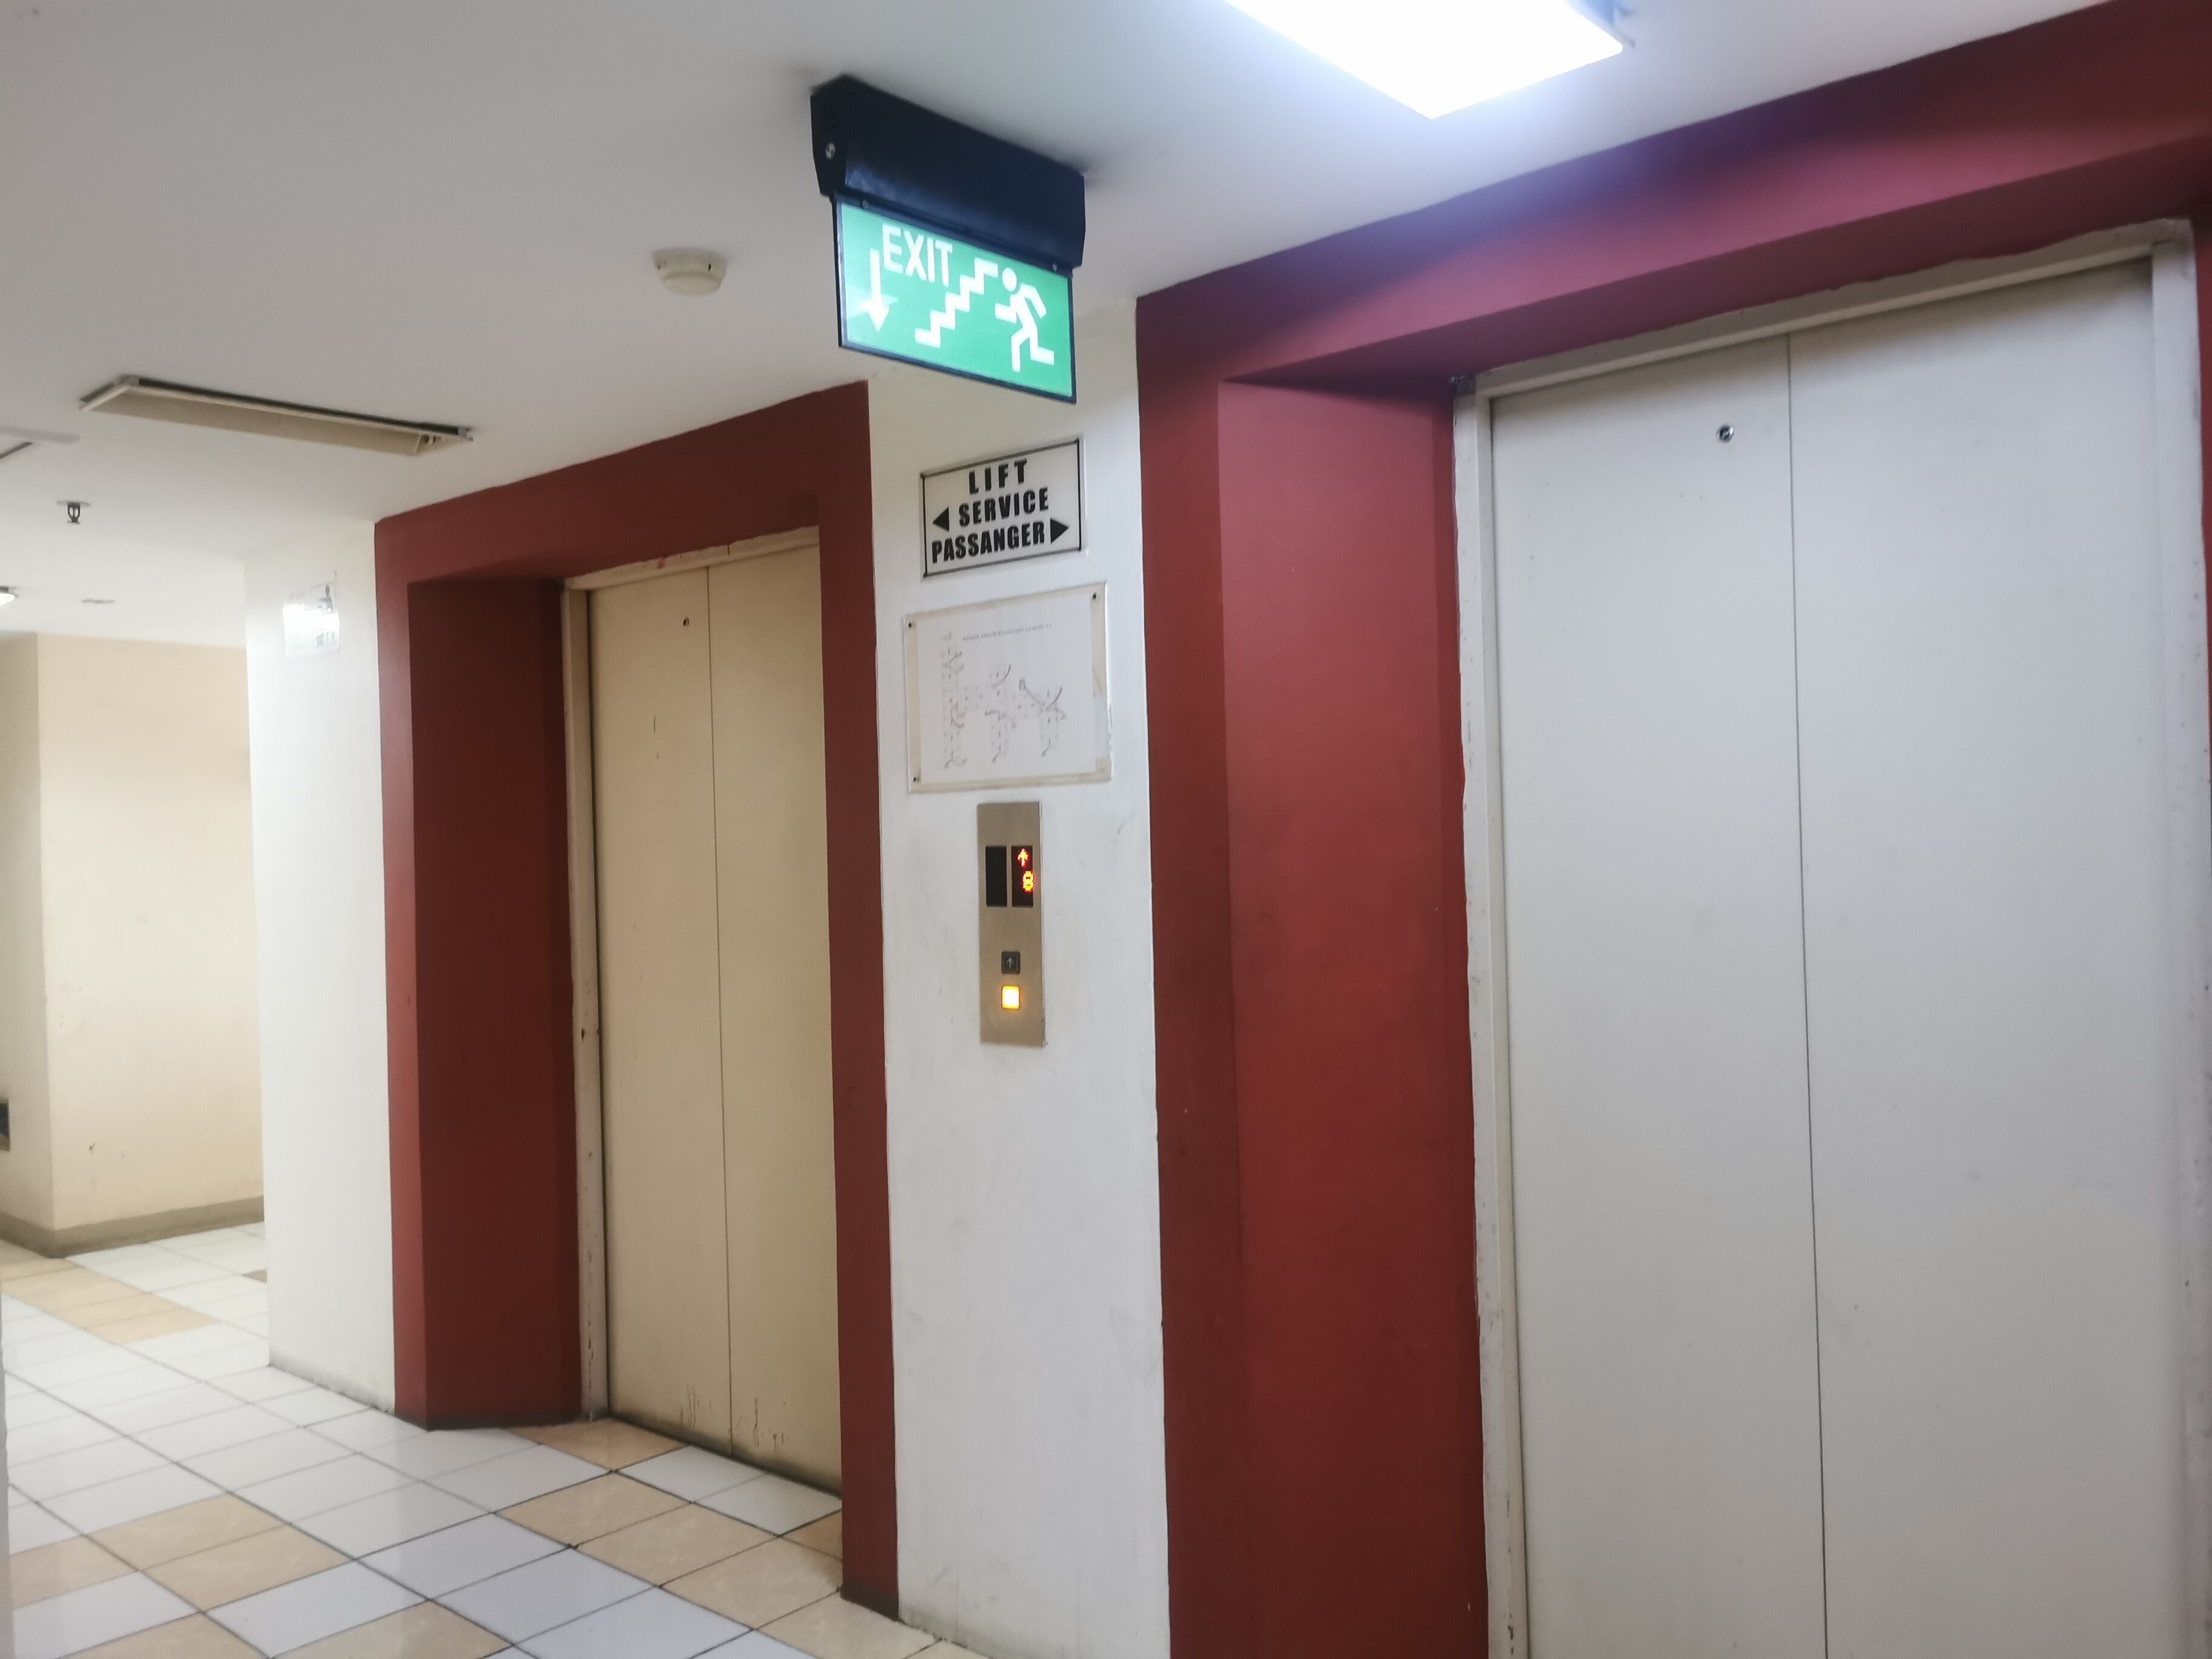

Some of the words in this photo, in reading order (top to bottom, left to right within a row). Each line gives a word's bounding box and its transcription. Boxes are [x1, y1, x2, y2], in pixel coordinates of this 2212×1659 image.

[882, 223, 953, 287] EXIT
[968, 458, 1027, 495] LIFT
[959, 487, 1049, 527] SERVICE
[932, 521, 1045, 564] PASSANGER
